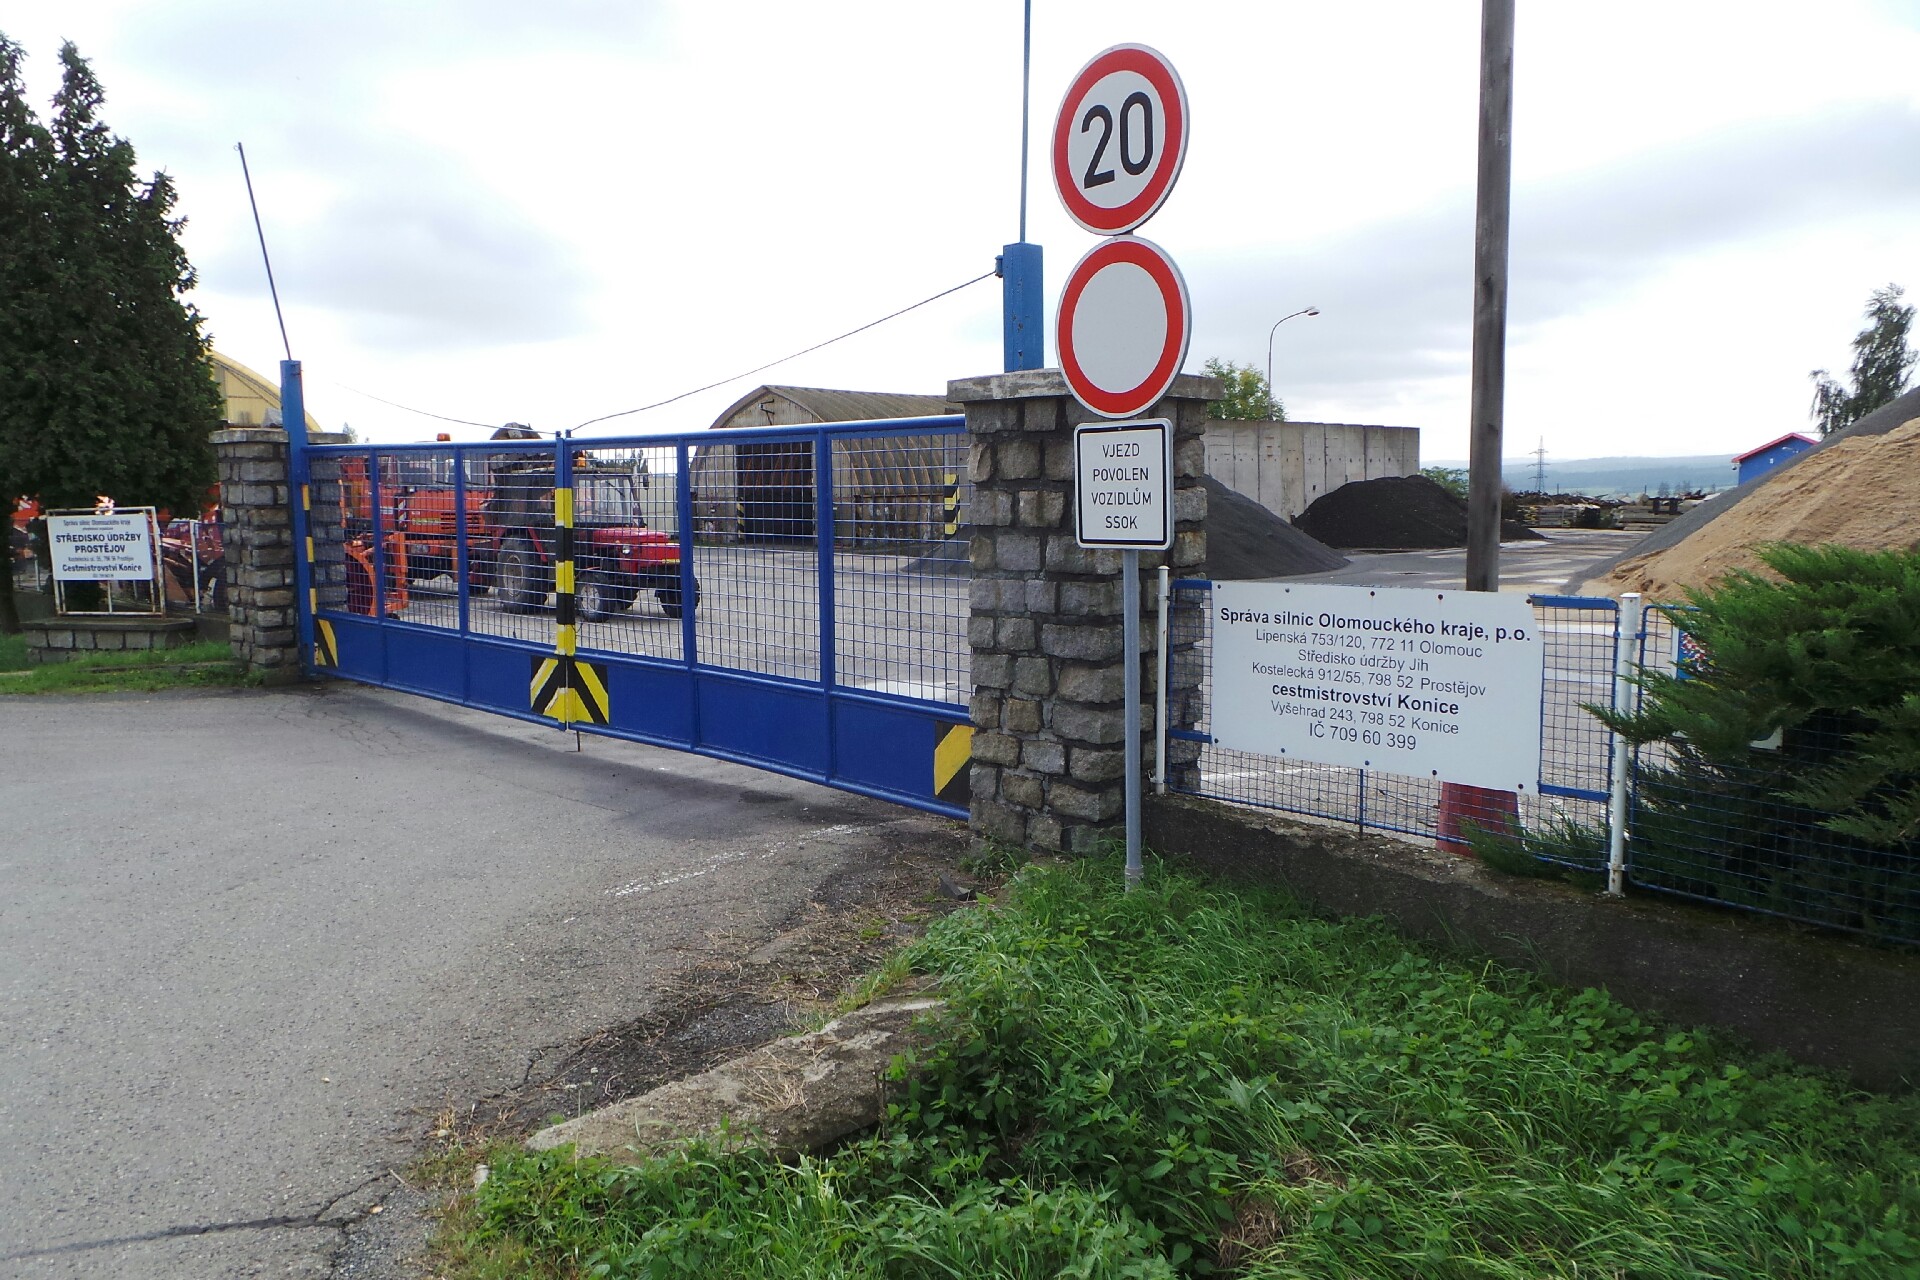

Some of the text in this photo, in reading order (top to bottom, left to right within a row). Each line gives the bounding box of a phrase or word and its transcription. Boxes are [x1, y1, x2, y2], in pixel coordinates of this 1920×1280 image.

[1081, 91, 1154, 189] 20
[1102, 443, 1140, 458] VJEZD
[1093, 468, 1149, 482] POVOLEN
[1091, 487, 1152, 505] VOZIDLŮM
[1105, 516, 1138, 529] SSOK
[55, 531, 141, 543] STŘEDISKO ÚDRŽBY
[75, 543, 126, 553] PROSTĚJOV
[62, 563, 142, 572] Cestmistrovství Konice
[1221, 608, 1530, 643] Správa silnic Olomouckého kraje, p.o.
[1256, 628, 1482, 658] Lipenská 753/120, 772 11 Olomouc
[1298, 649, 1428, 673] Středisko údržby Jih
[1253, 662, 1486, 698] Kostelecká 912/55, 798 52 Prostějov
[1271, 682, 1458, 714] cestmistrovství Konice
[1271, 700, 1458, 734] Vyšehrad 243, 798 52 Konice
[1310, 720, 1416, 750] IČ 709 60 399
